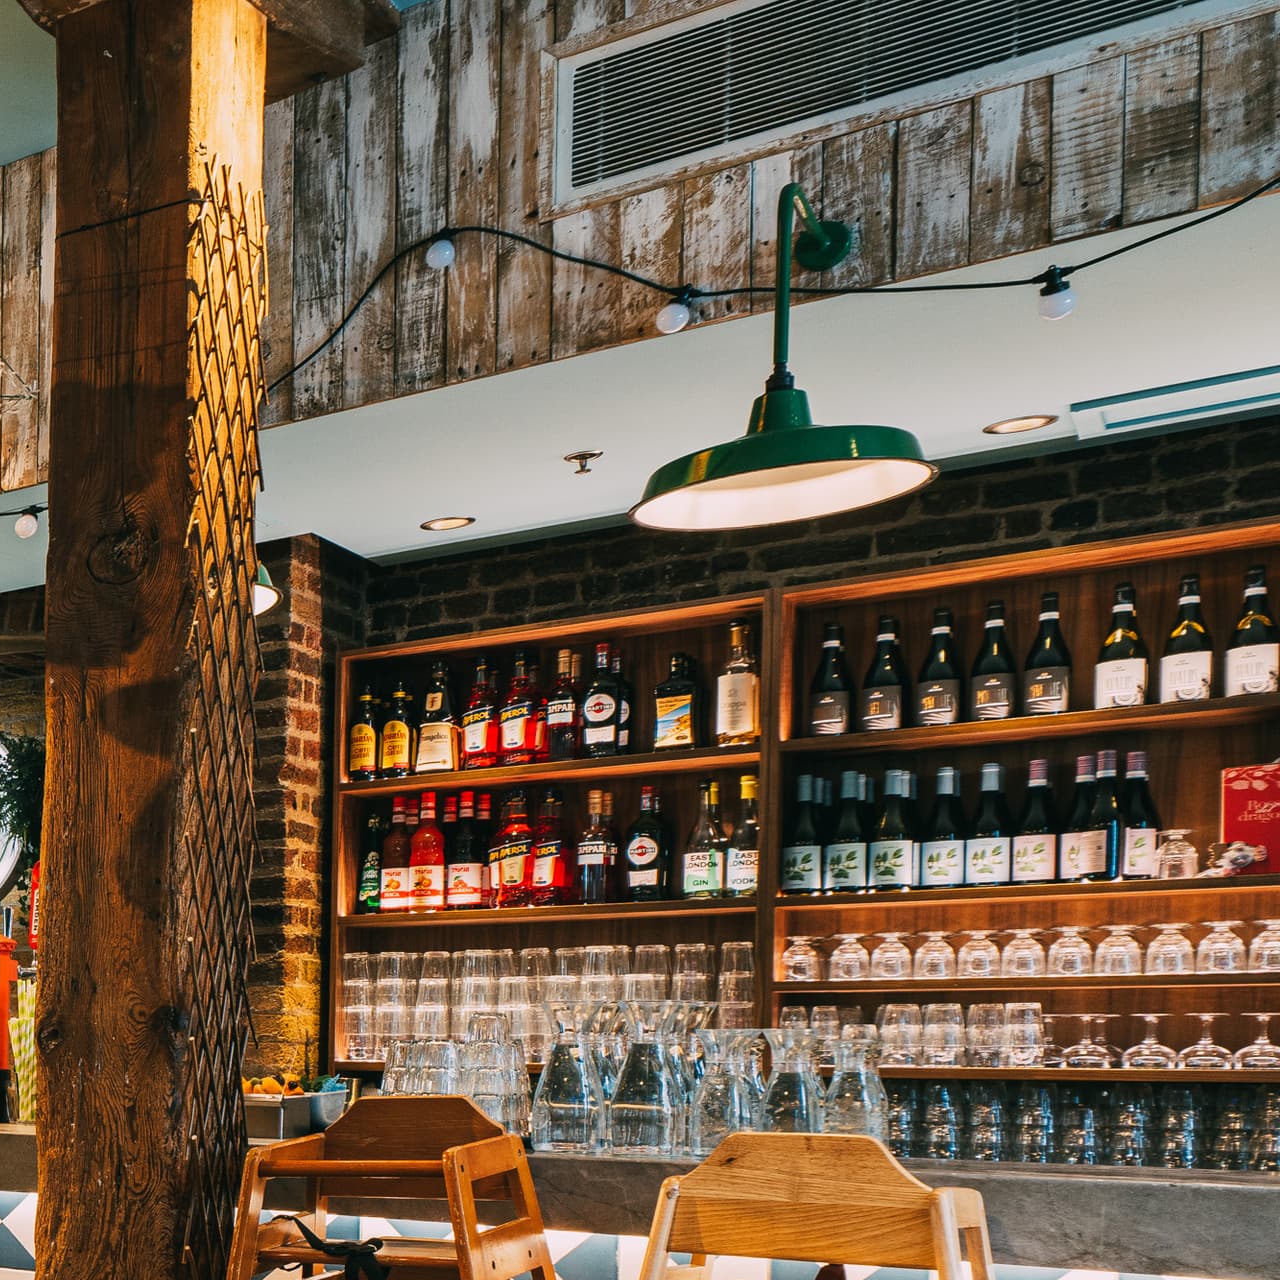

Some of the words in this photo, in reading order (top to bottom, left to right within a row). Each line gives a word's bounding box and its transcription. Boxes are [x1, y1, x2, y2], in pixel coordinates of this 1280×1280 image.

[548, 703, 575, 714] AMPARI
[691, 853, 713, 862] EAST
[735, 852, 759, 860] EAST
[729, 859, 759, 867] LONDO
[692, 879, 709, 887] GIN
